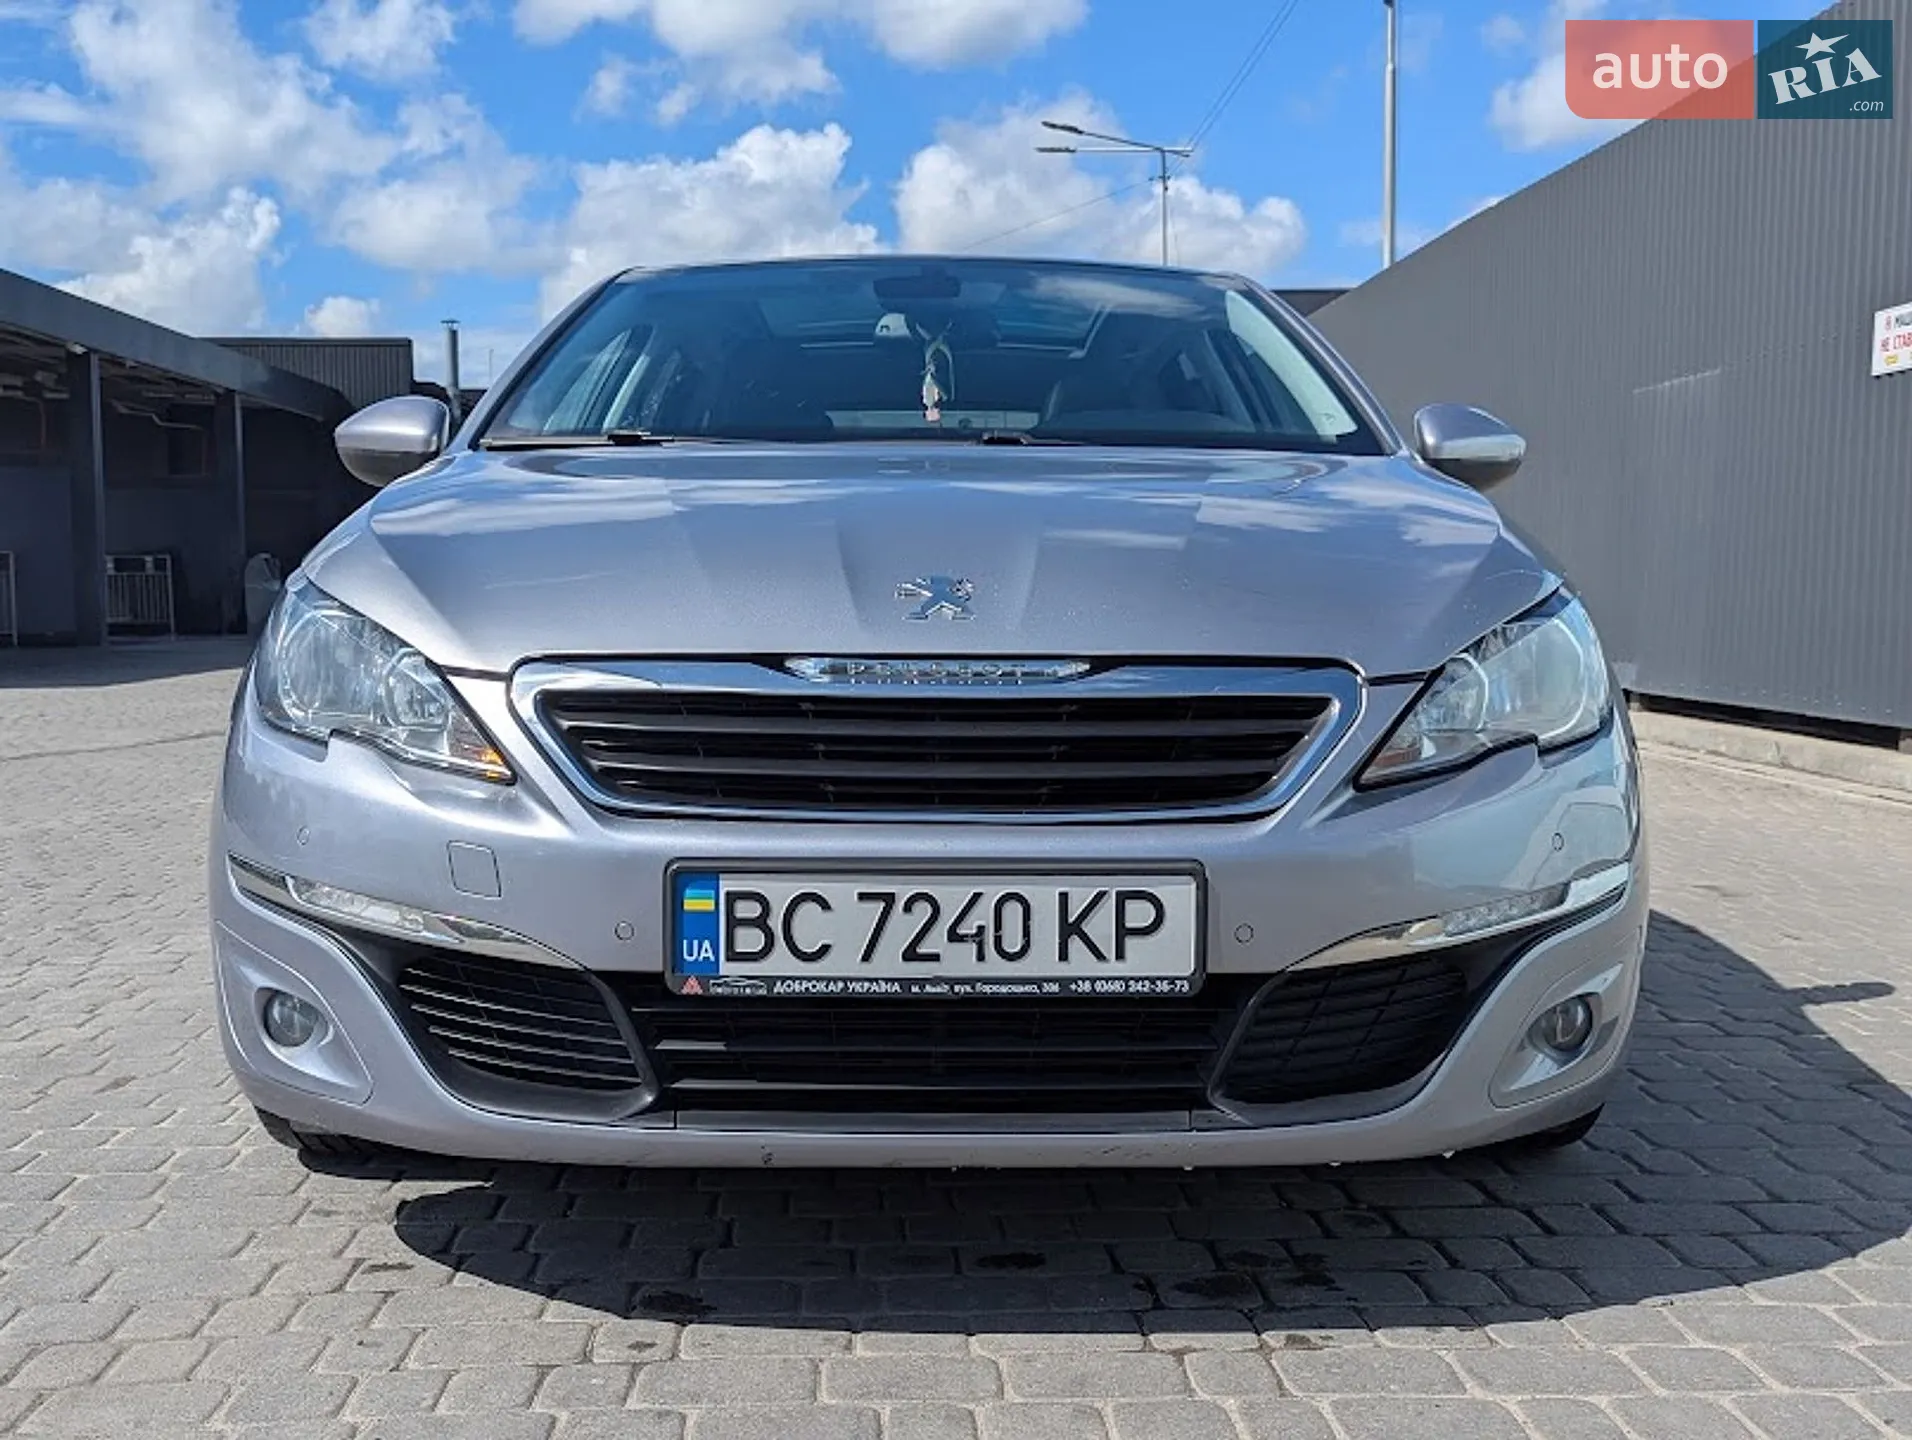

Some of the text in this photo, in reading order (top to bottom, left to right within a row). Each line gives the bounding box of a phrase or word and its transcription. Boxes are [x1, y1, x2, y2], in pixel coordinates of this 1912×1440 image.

[856, 891, 1032, 962] 7240
[683, 939, 715, 962] UA
[773, 979, 845, 994] ДОБРОКАР
[847, 979, 901, 993] УКРАЇНА
